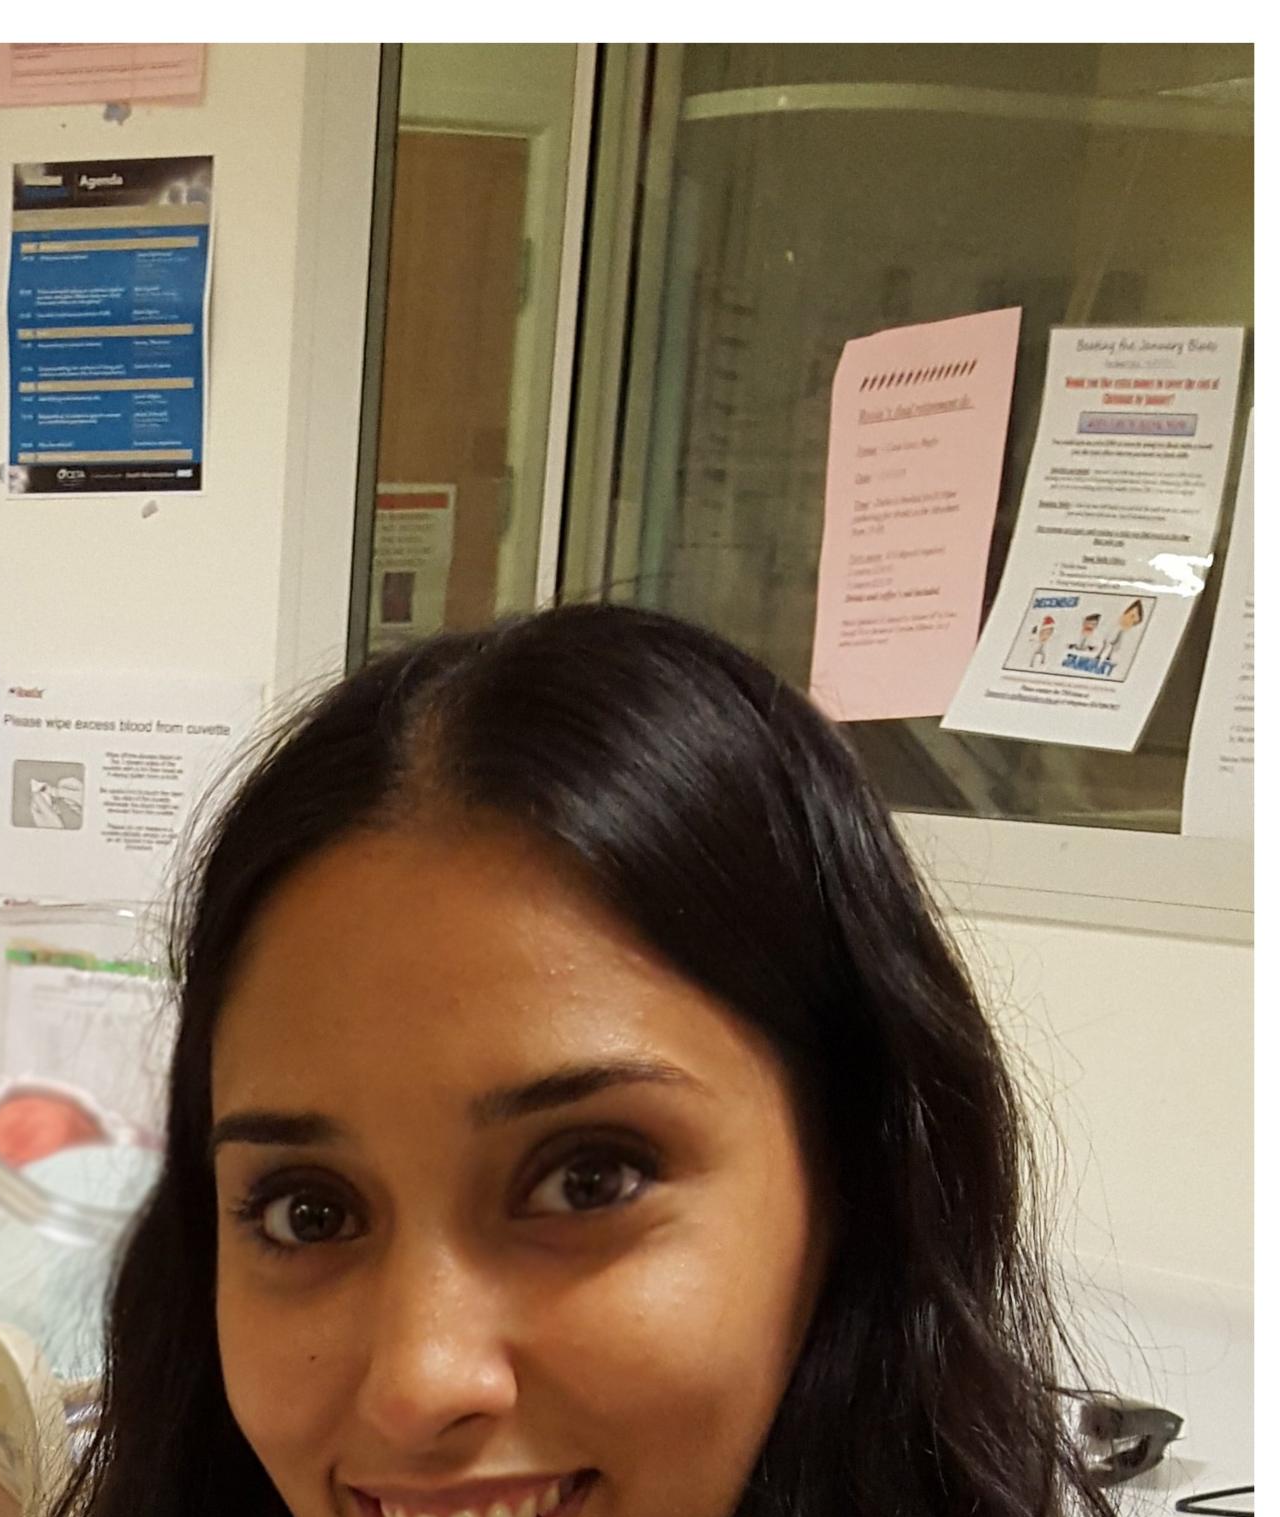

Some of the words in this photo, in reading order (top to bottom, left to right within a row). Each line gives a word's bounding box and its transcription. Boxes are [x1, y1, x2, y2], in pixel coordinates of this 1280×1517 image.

[79, 174, 123, 190] Agenda
[4, 713, 42, 728] Please
[46, 719, 72, 731] wipe
[75, 720, 115, 732] excess
[120, 719, 153, 733] blood
[156, 720, 183, 733] from
